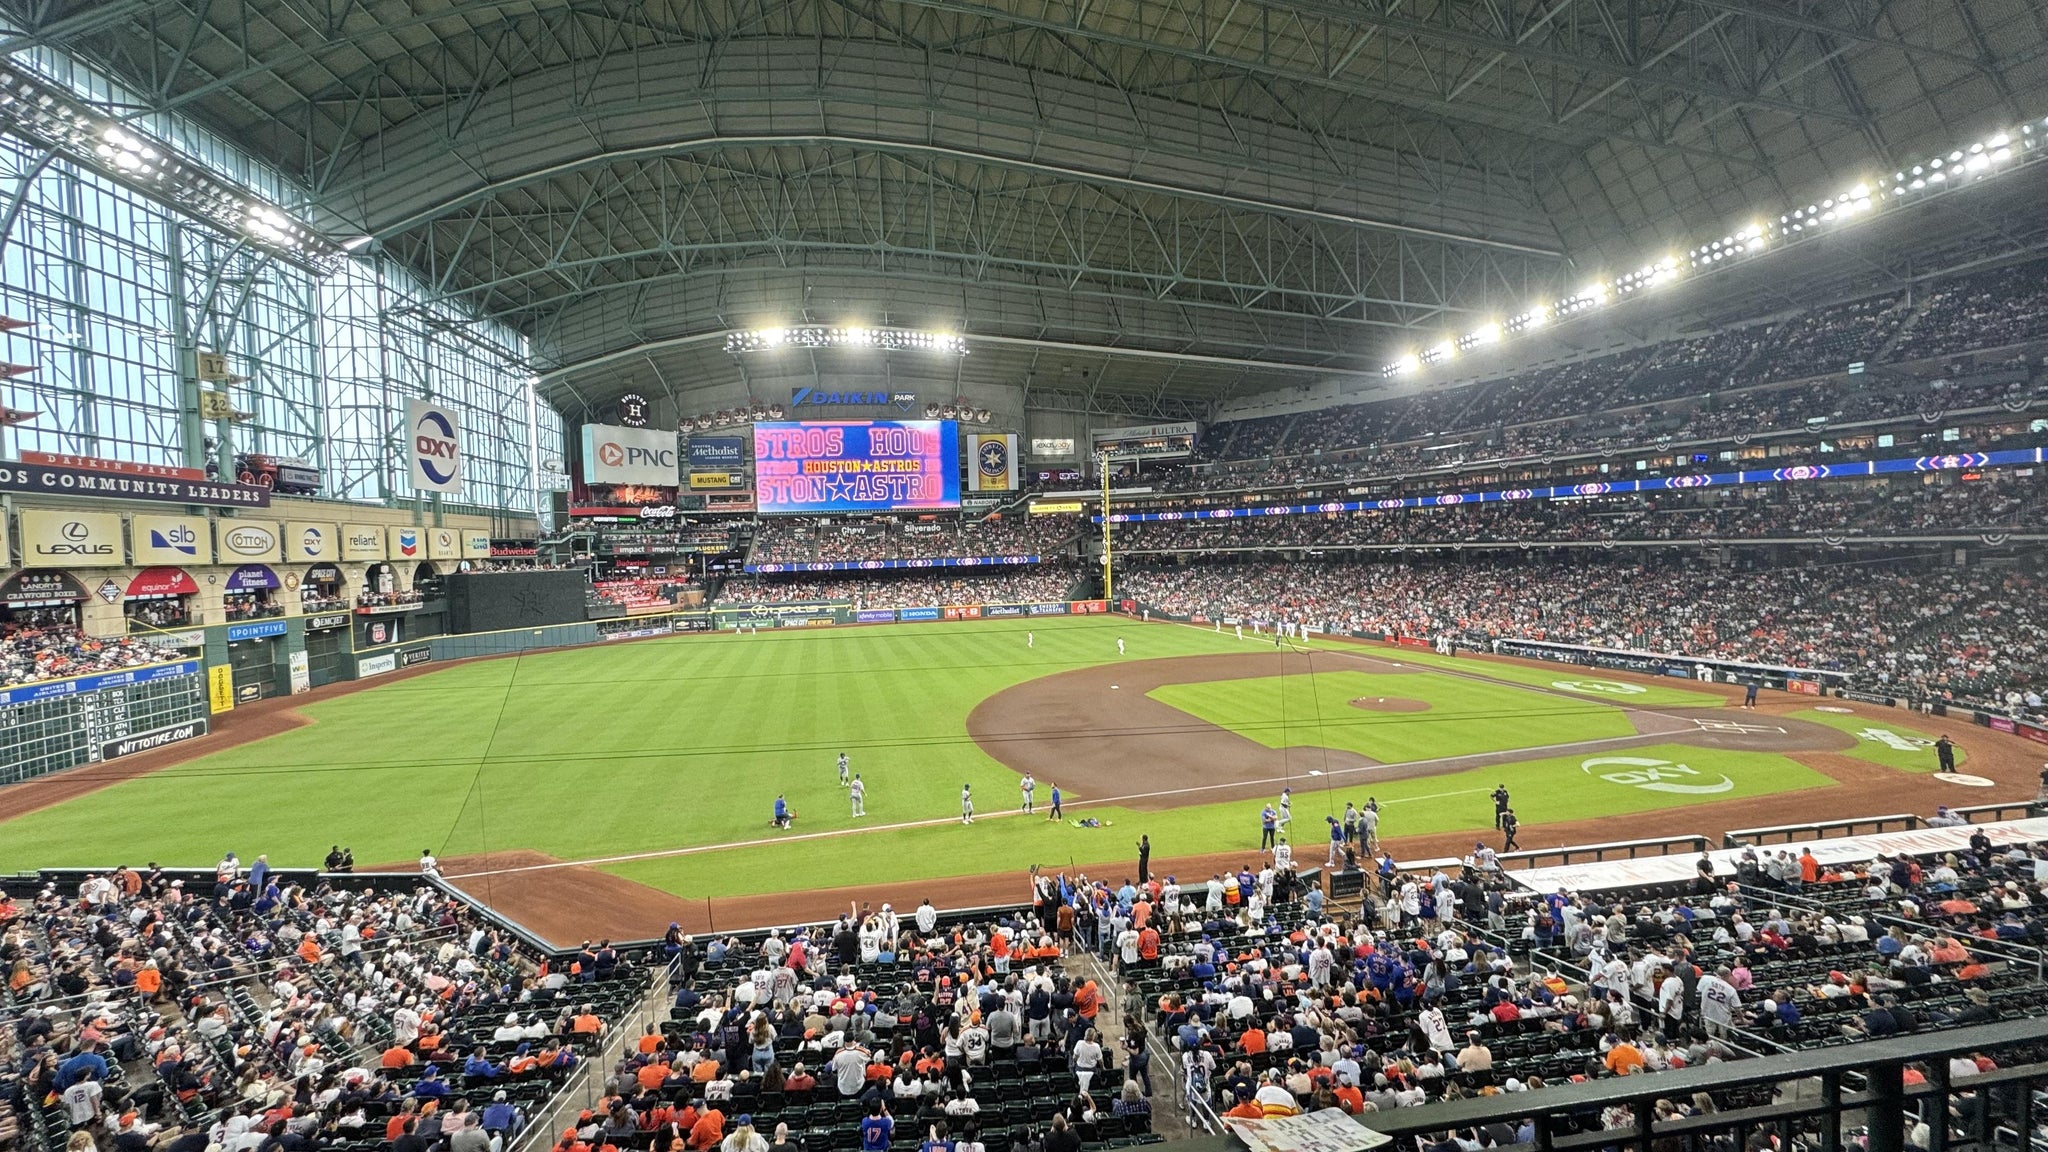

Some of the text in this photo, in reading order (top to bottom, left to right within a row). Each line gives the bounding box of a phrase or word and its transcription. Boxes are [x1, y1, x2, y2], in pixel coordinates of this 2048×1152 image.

[206, 360, 224, 374] 17
[812, 391, 888, 404] DAIKIN
[210, 400, 228, 412] 22
[630, 404, 642, 416] H
[1158, 426, 1188, 435] ULTRA
[416, 436, 457, 460] OXY
[692, 445, 739, 456] Methodist
[626, 446, 674, 468] PNC
[47, 454, 180, 476] DAIKIN PARK
[804, 459, 861, 473] HOUSTON
[872, 459, 920, 472] ASTROS
[42, 472, 180, 496] COMMUNITY
[188, 485, 260, 502] LEADERS
[758, 476, 826, 504] STON
[169, 524, 196, 543] slb
[841, 527, 866, 535] Chevy
[904, 524, 942, 533] Silverado
[232, 532, 268, 549] COTTON
[350, 536, 377, 547] reliant
[36, 544, 114, 555] LEXUS
[490, 547, 537, 556] Budweiser
[238, 570, 263, 581] planet
[242, 577, 268, 586] fitness
[142, 583, 169, 592] equinor
[7, 592, 52, 600] CRAWFORD
[232, 623, 284, 636] 1POINTFIVE
[367, 658, 393, 672] Insperity
[34, 688, 65, 697] AIRLINES
[118, 726, 194, 755] NITTOTIRE.COM
[1600, 763, 1700, 784] OXY
[1855, 833, 1962, 854] DAIKIN
[1125, 941, 1136, 949] 44
[1320, 960, 1329, 968] 39
[1372, 963, 1386, 974] 33
[755, 982, 766, 990] 22
[778, 979, 788, 988] 27
[1707, 988, 1726, 1003] 22
[1005, 1002, 1013, 1011] 11
[1433, 1018, 1446, 1032] 27
[968, 1038, 982, 1049] 34
[74, 1093, 85, 1103] 12
[216, 1131, 224, 1143] 3
[867, 1127, 881, 1142] 17
